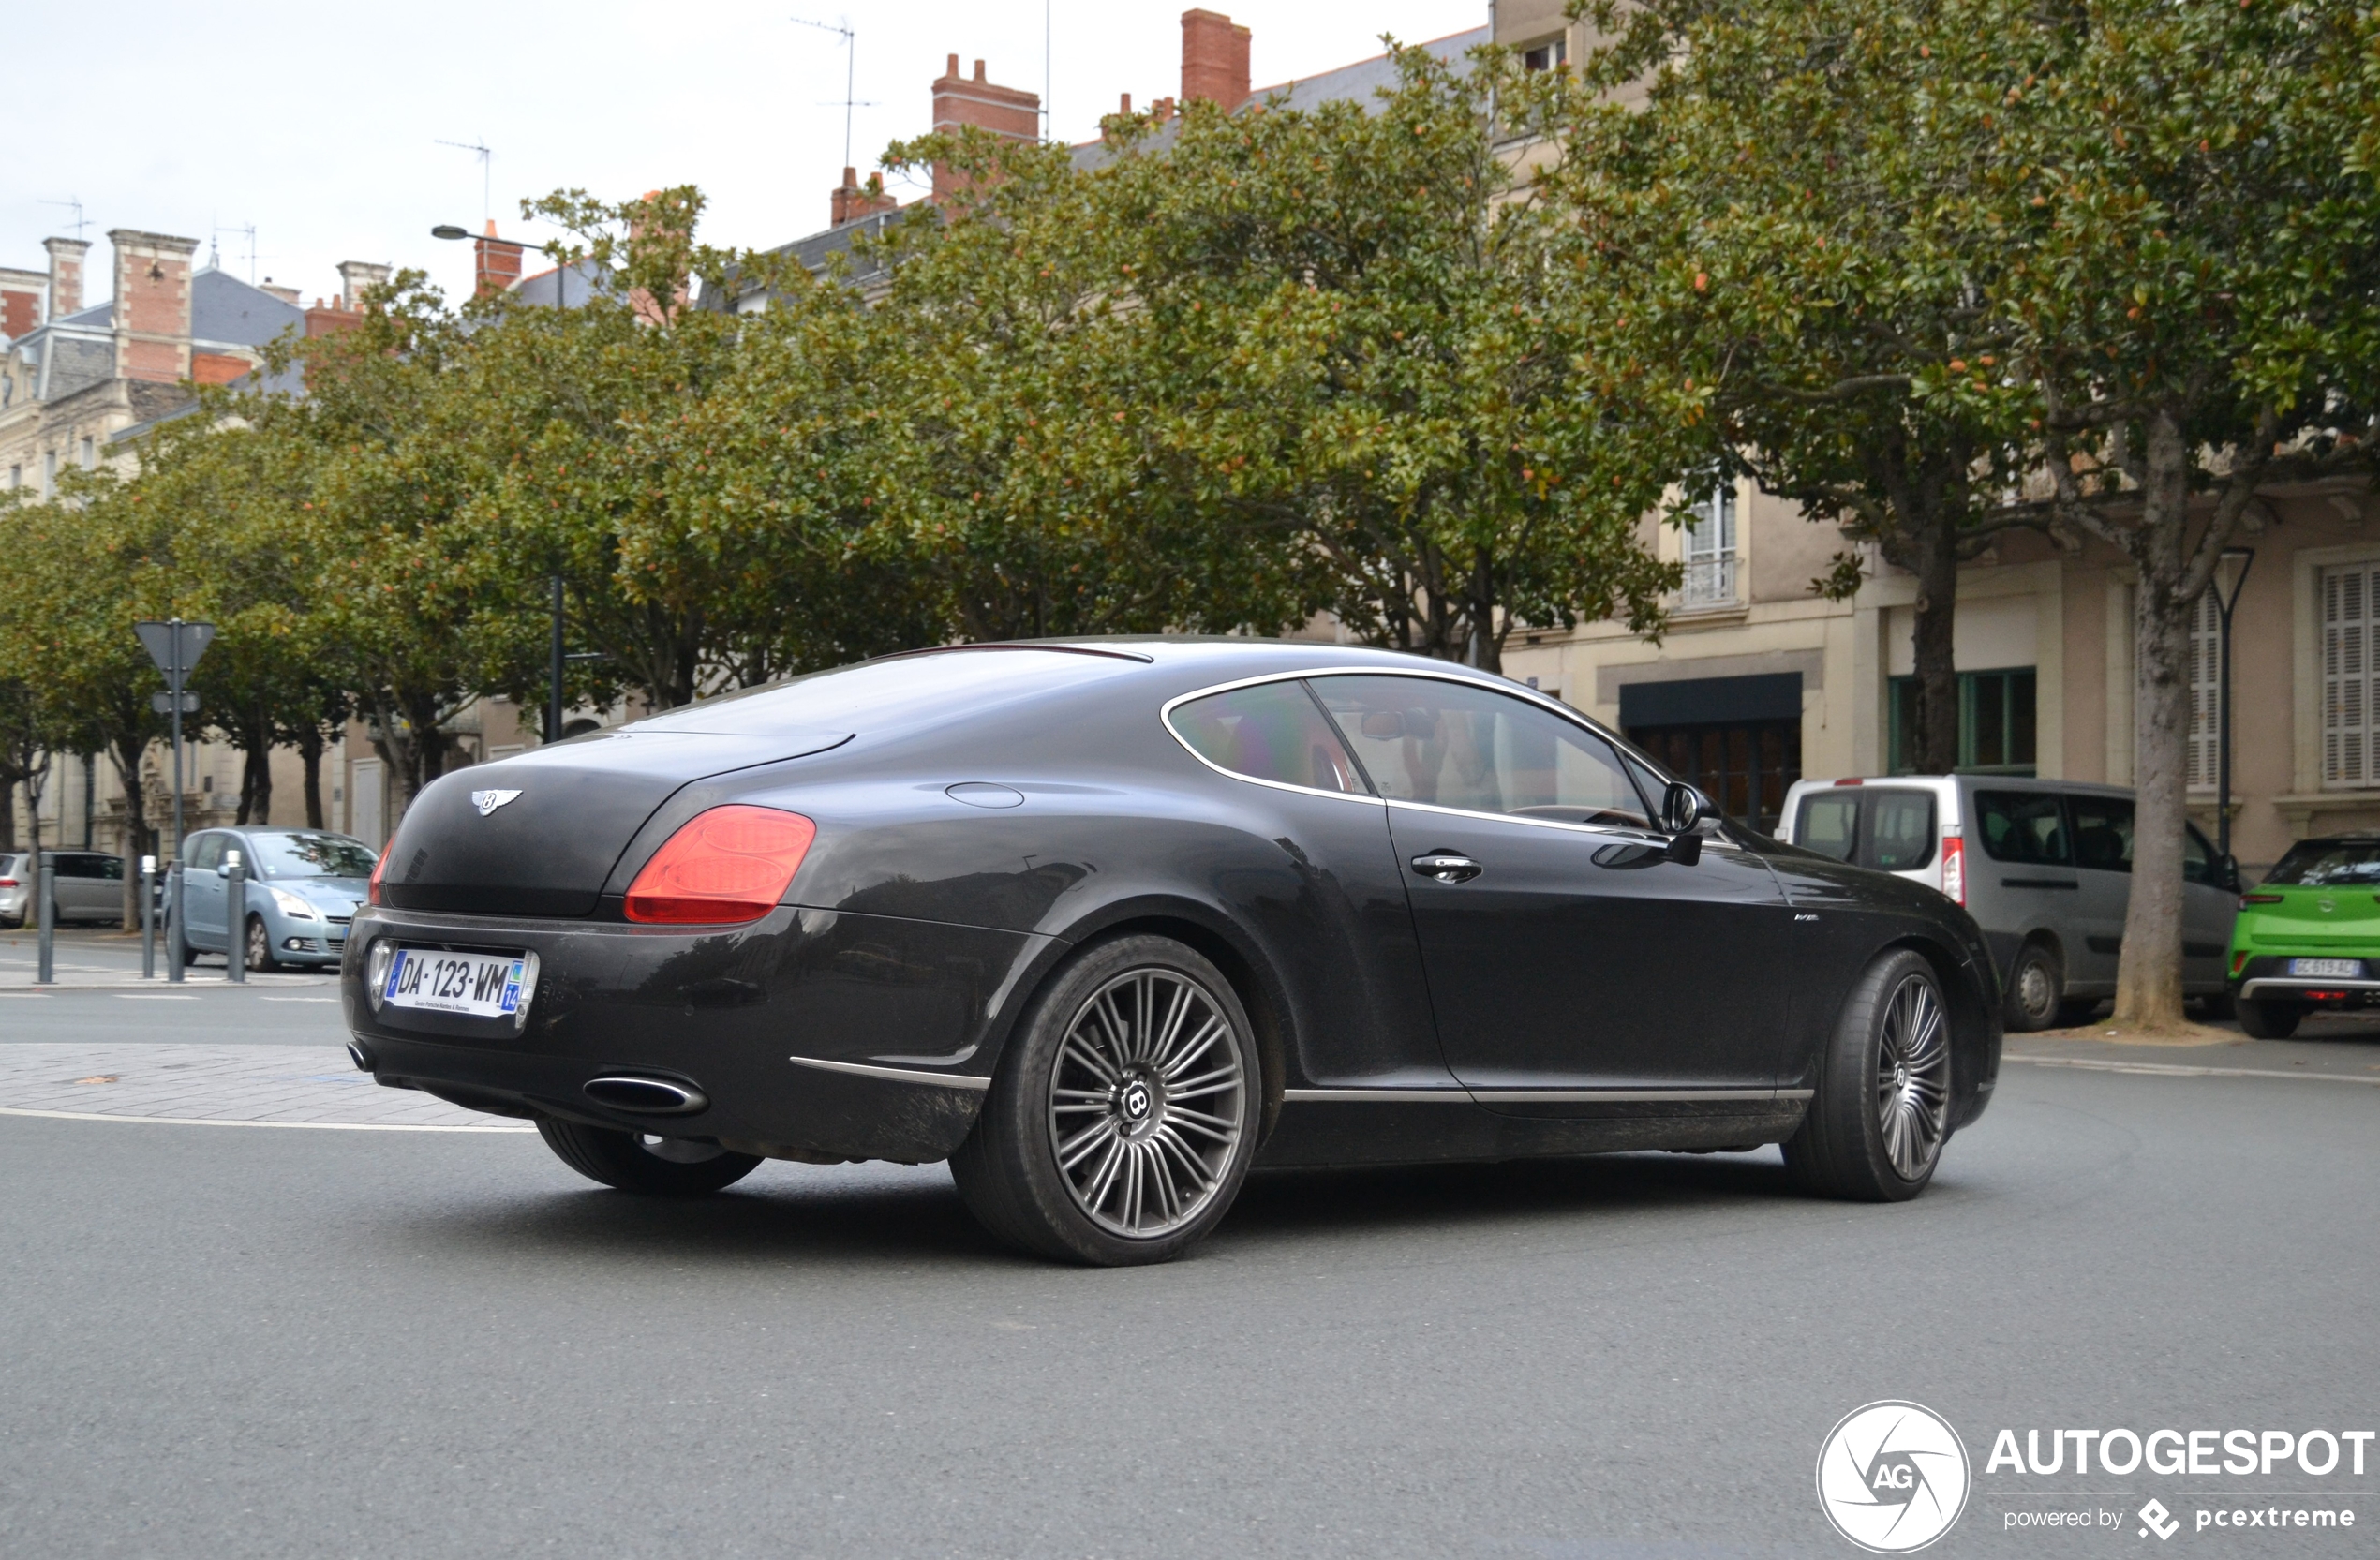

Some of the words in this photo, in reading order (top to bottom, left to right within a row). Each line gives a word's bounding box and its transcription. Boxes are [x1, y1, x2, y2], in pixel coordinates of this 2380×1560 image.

[390, 980, 396, 989] F
[398, 958, 509, 1003] DA-123-WM
[505, 990, 518, 1007] 14
[1129, 1090, 1147, 1115] B
